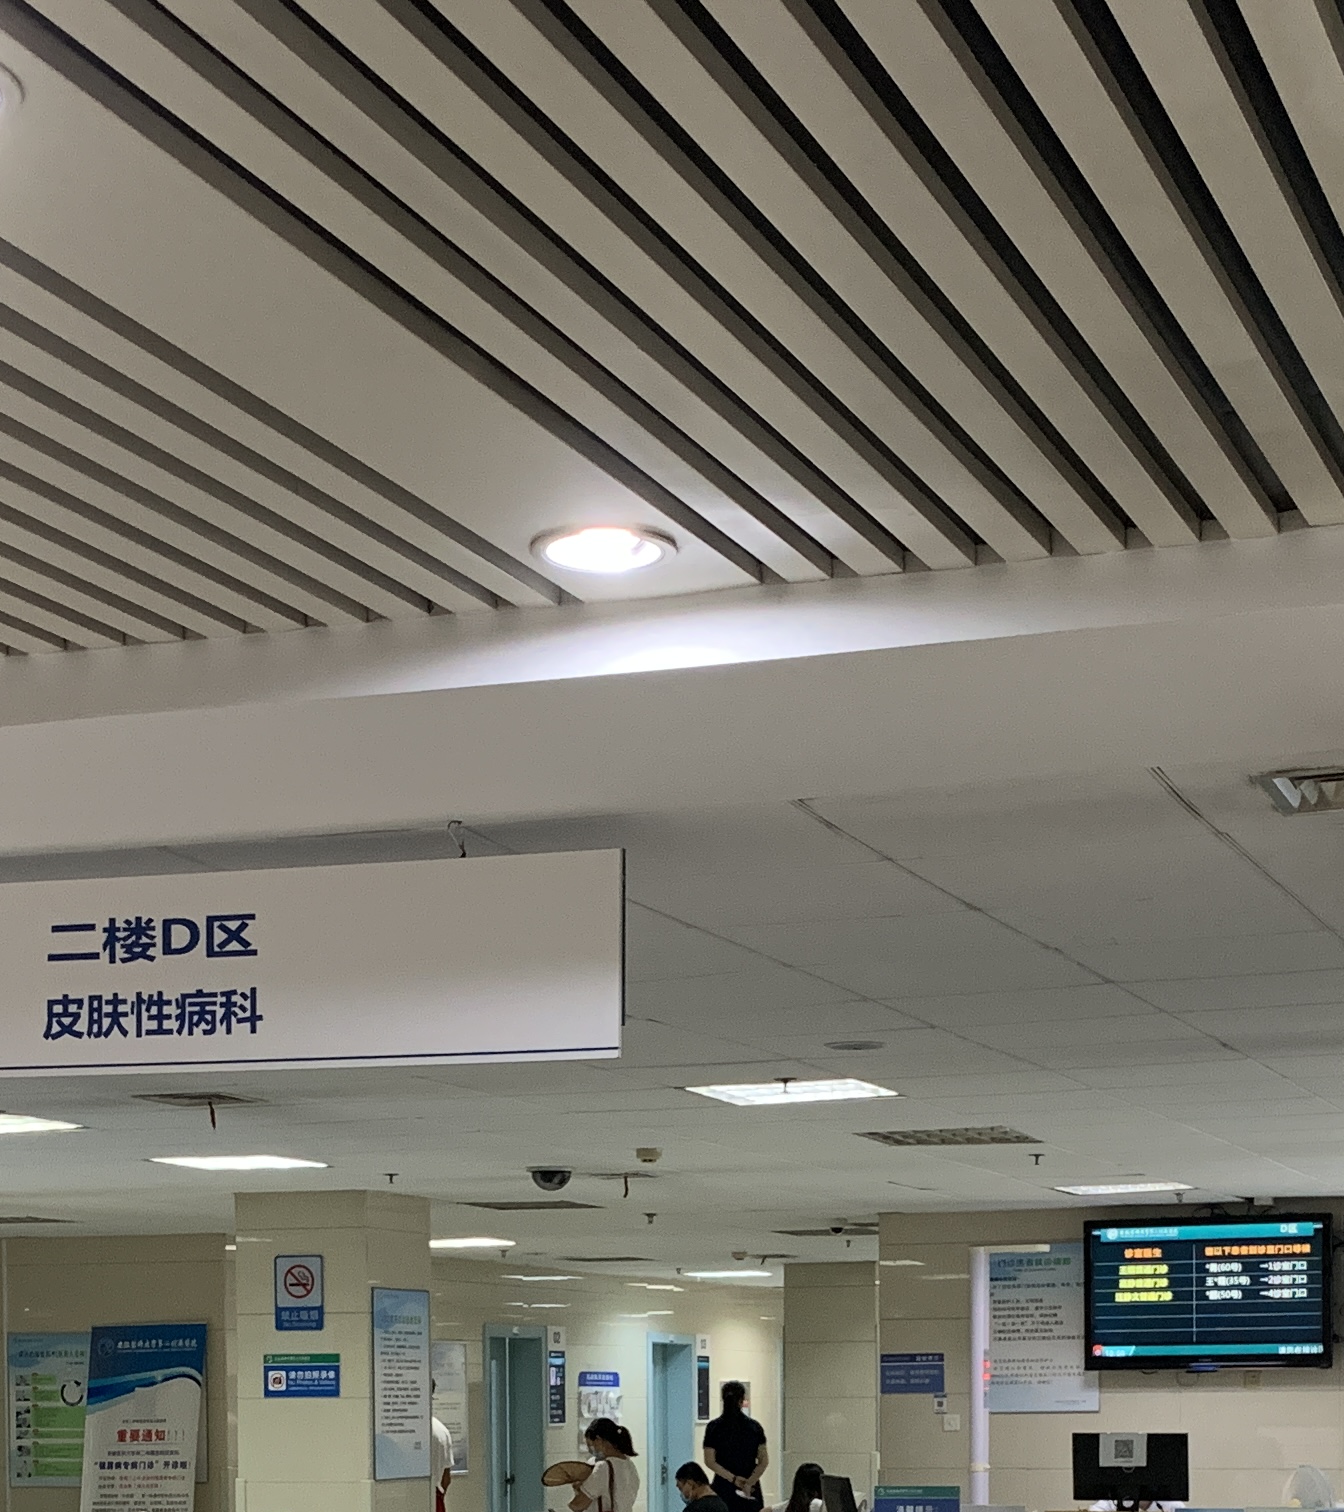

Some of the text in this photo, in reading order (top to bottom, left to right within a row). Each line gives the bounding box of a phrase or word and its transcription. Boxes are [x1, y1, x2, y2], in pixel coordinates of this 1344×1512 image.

[47, 913, 258, 964] 二楼D区
[43, 987, 263, 1041] 皮肤性病科
[281, 1310, 319, 1321] 禁止吸烟
[288, 1371, 336, 1380] 请勿拍照录像
